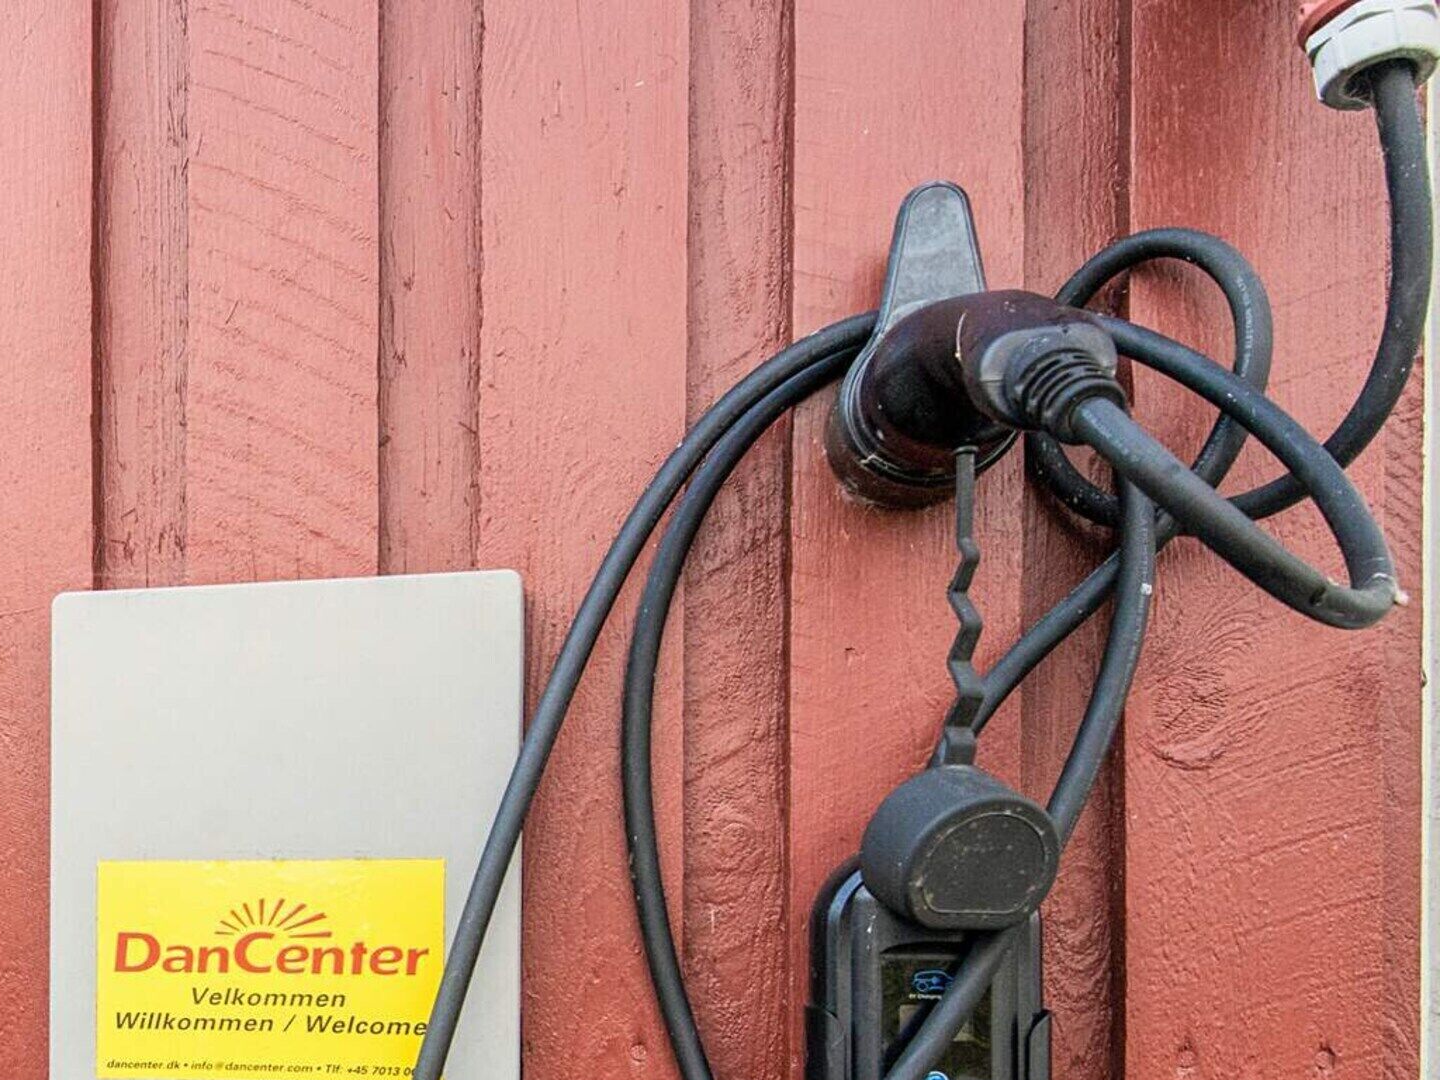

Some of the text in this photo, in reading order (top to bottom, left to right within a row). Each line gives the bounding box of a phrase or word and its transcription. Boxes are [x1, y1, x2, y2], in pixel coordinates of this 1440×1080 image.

[114, 932, 429, 975] DanCenter
[191, 986, 346, 1007] Velkommen
[116, 1011, 427, 1036] Willkommen / Welcome
[106, 1059, 180, 1070] dancenter.dk
[372, 1065, 400, 1077] 7013
